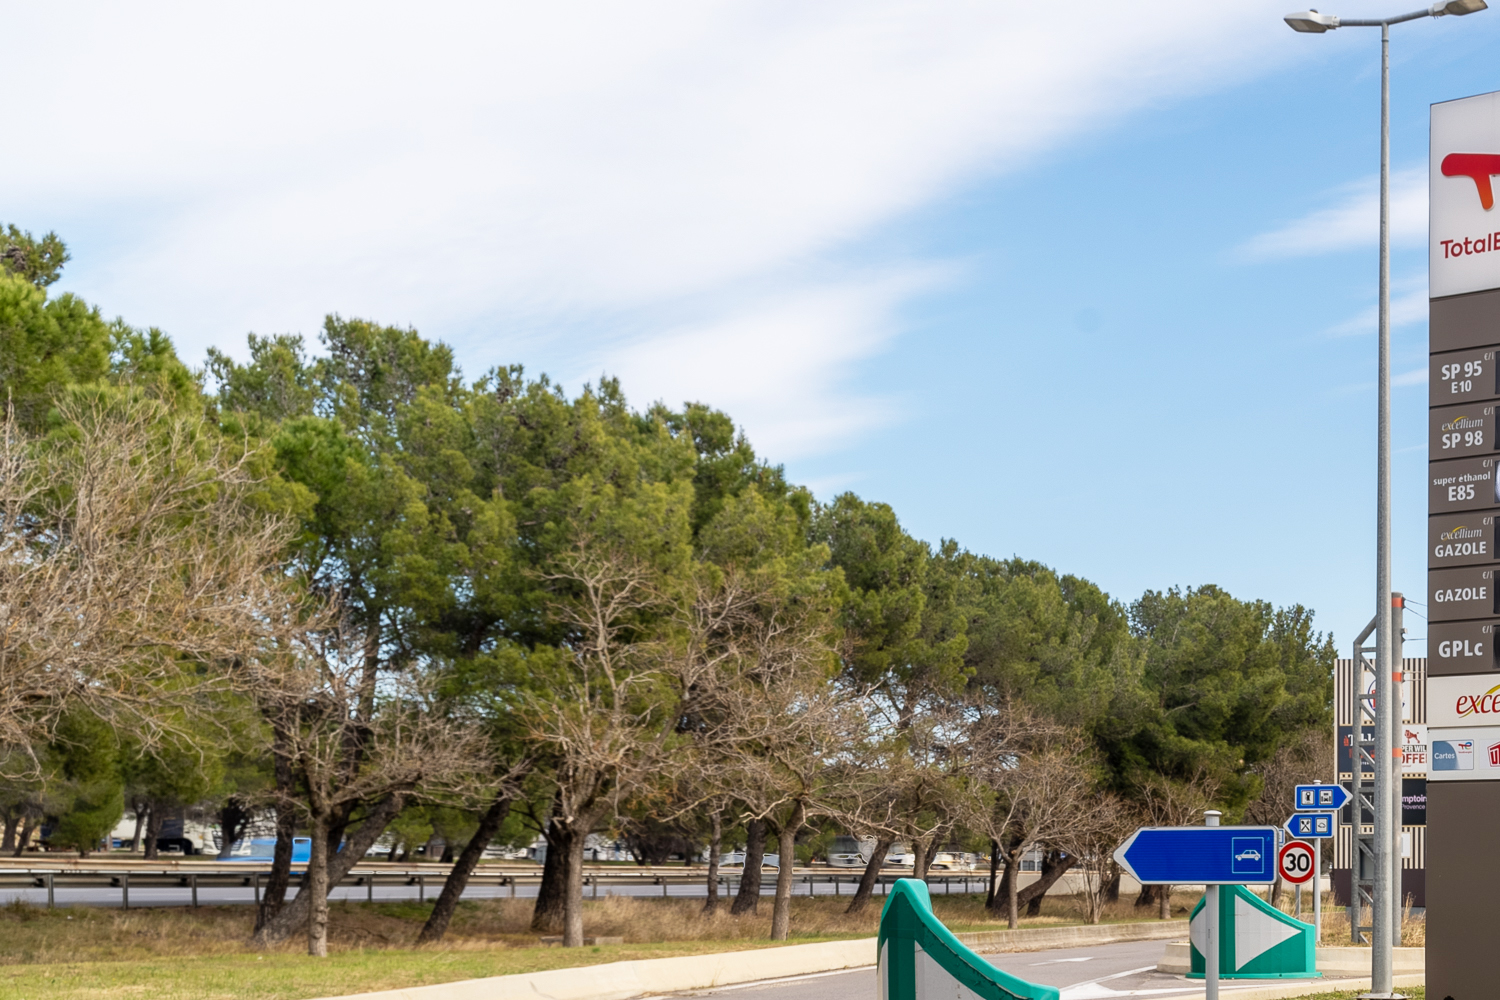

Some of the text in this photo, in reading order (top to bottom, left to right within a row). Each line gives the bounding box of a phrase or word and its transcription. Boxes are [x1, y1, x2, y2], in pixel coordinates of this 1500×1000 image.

[1441, 361, 1483, 380] SP 95
[1441, 418, 1484, 432] excellium
[1442, 431, 1483, 449] SP 98
[1433, 471, 1491, 487] super éthanol
[1448, 484, 1475, 501] E85
[1440, 528, 1483, 541] excellium
[1434, 541, 1487, 558] GAZOLE
[1434, 587, 1487, 602] GAZOLE
[1438, 640, 1484, 658] GPLc
[1434, 752, 1456, 760] Cartes
[1284, 853, 1310, 872] 30
